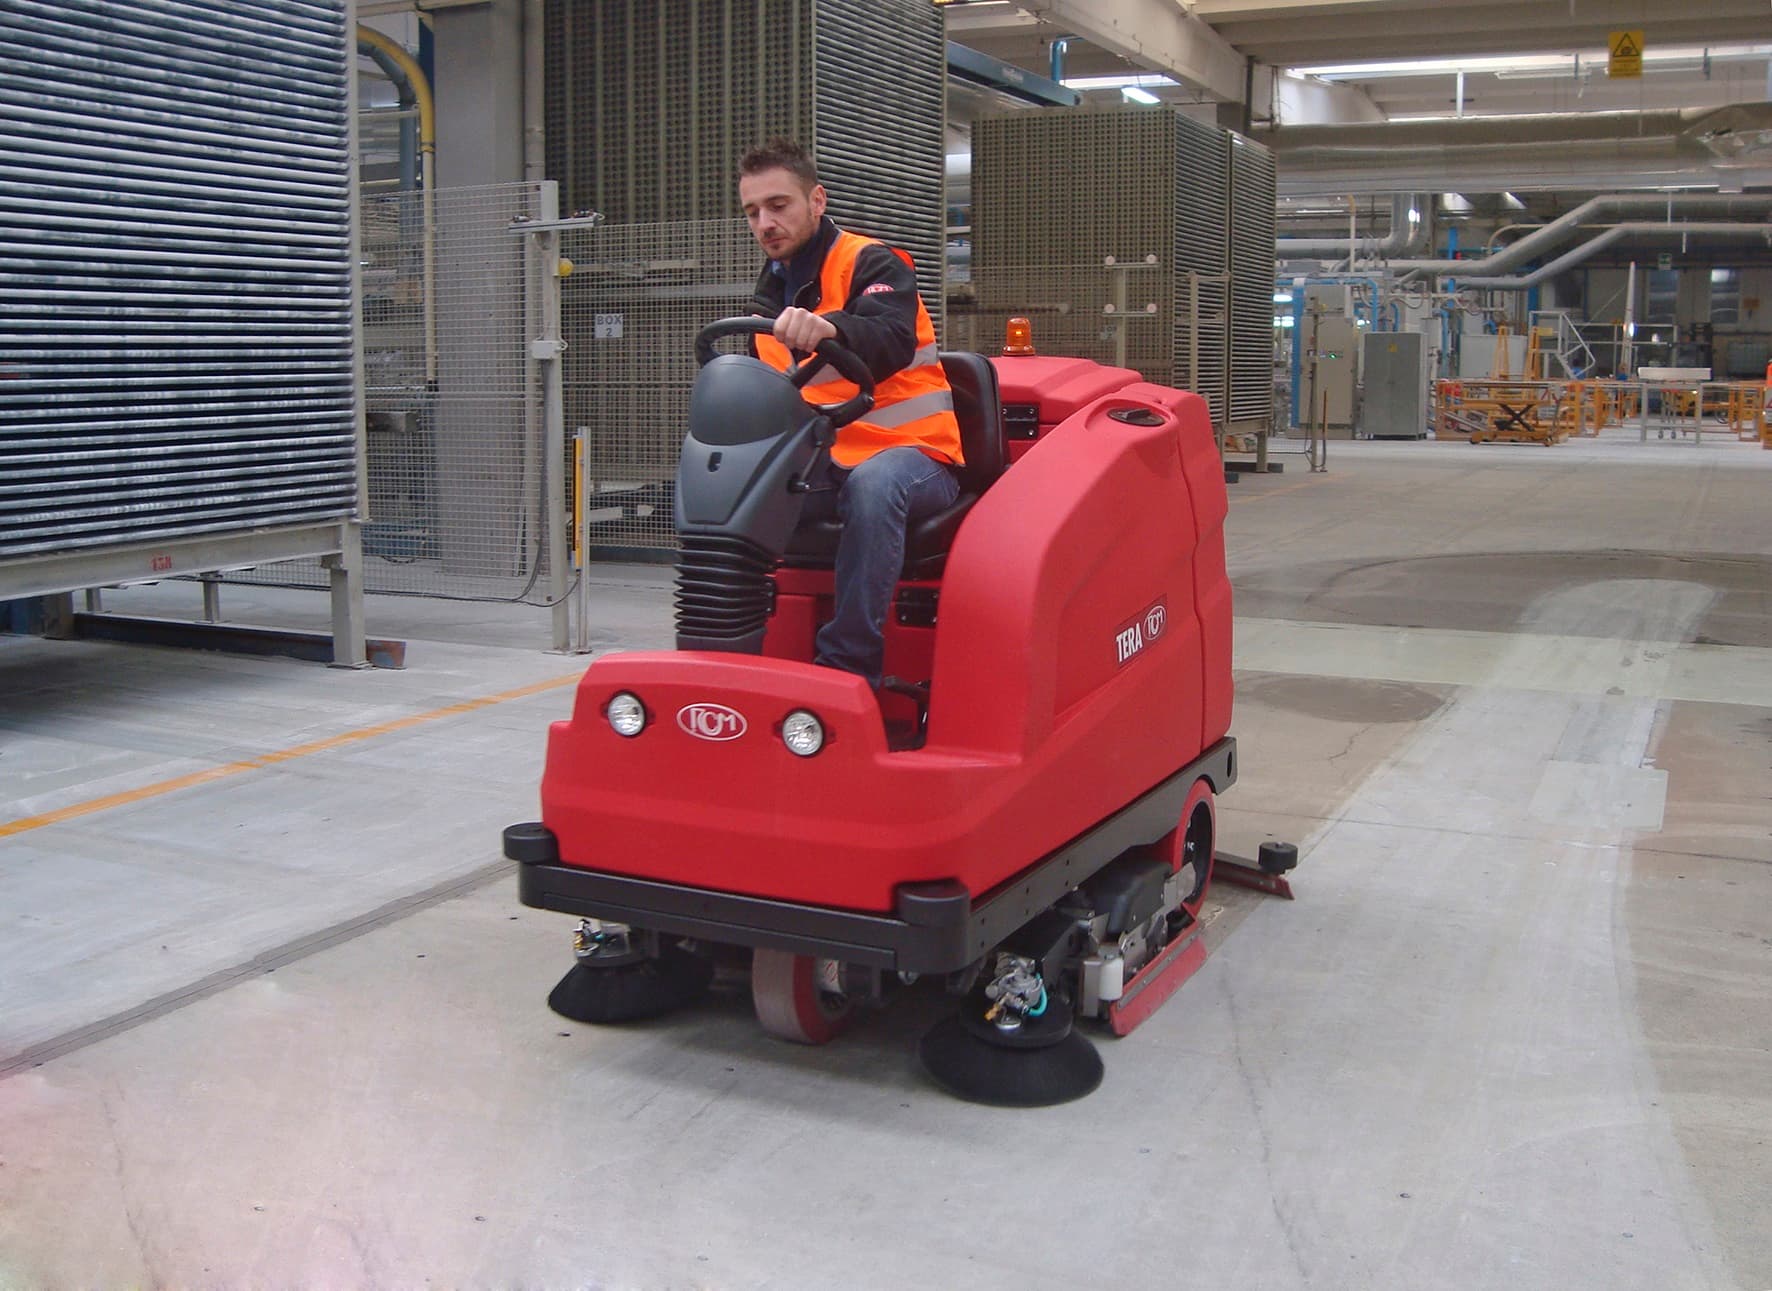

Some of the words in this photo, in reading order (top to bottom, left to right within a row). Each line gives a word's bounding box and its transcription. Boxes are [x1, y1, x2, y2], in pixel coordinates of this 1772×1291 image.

[596, 315, 622, 326] BOX
[606, 327, 613, 337] 2
[1116, 622, 1143, 663] TERA
